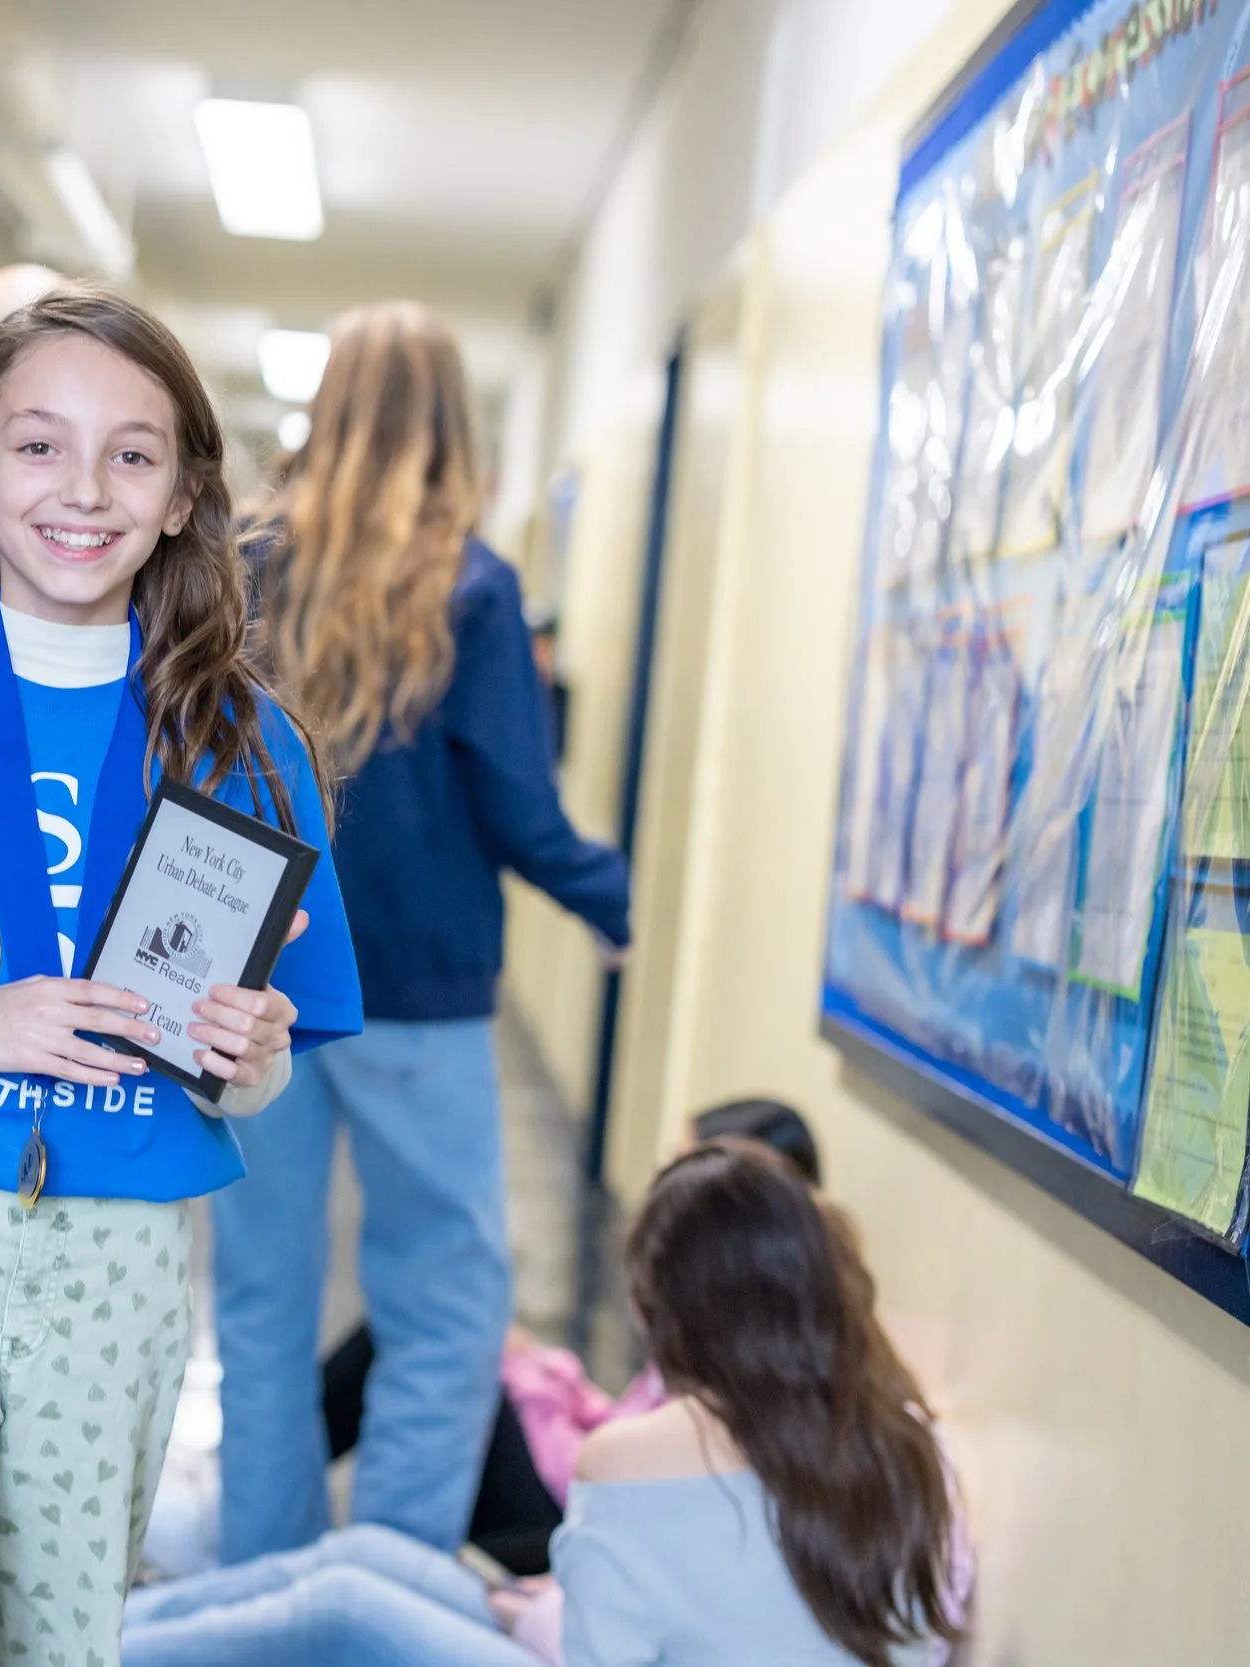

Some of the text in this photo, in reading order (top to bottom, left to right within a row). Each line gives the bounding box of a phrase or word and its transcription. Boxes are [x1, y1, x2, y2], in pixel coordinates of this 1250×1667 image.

[180, 834, 246, 884] New York City
[157, 853, 249, 914] Urban Debate League
[135, 948, 158, 967] NYC
[159, 961, 202, 994] Reads
[149, 1002, 182, 1036] Team
